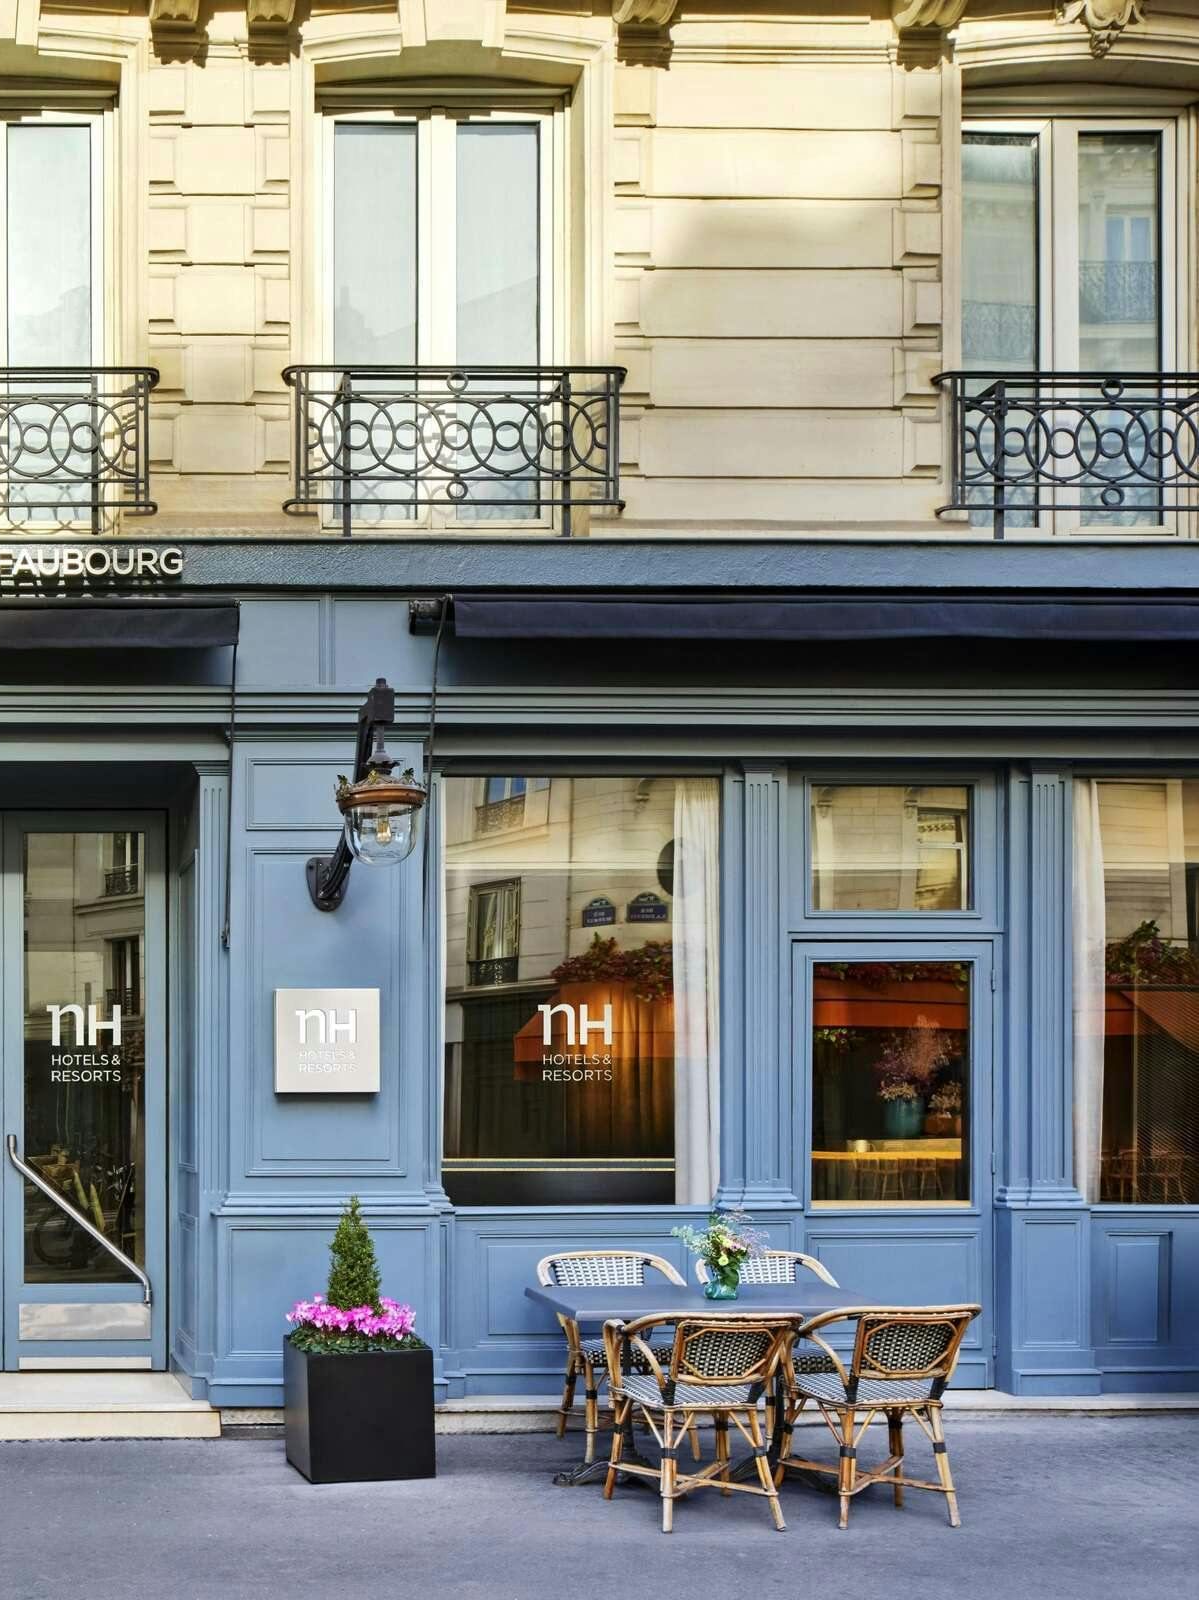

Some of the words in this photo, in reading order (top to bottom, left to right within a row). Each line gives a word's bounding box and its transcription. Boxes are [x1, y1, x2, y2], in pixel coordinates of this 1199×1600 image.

[51, 1054, 109, 1066] HOTELS
[543, 1054, 600, 1066] HOTELS
[51, 1070, 122, 1082] RESORTS
[543, 1069, 612, 1081] RESORTS
